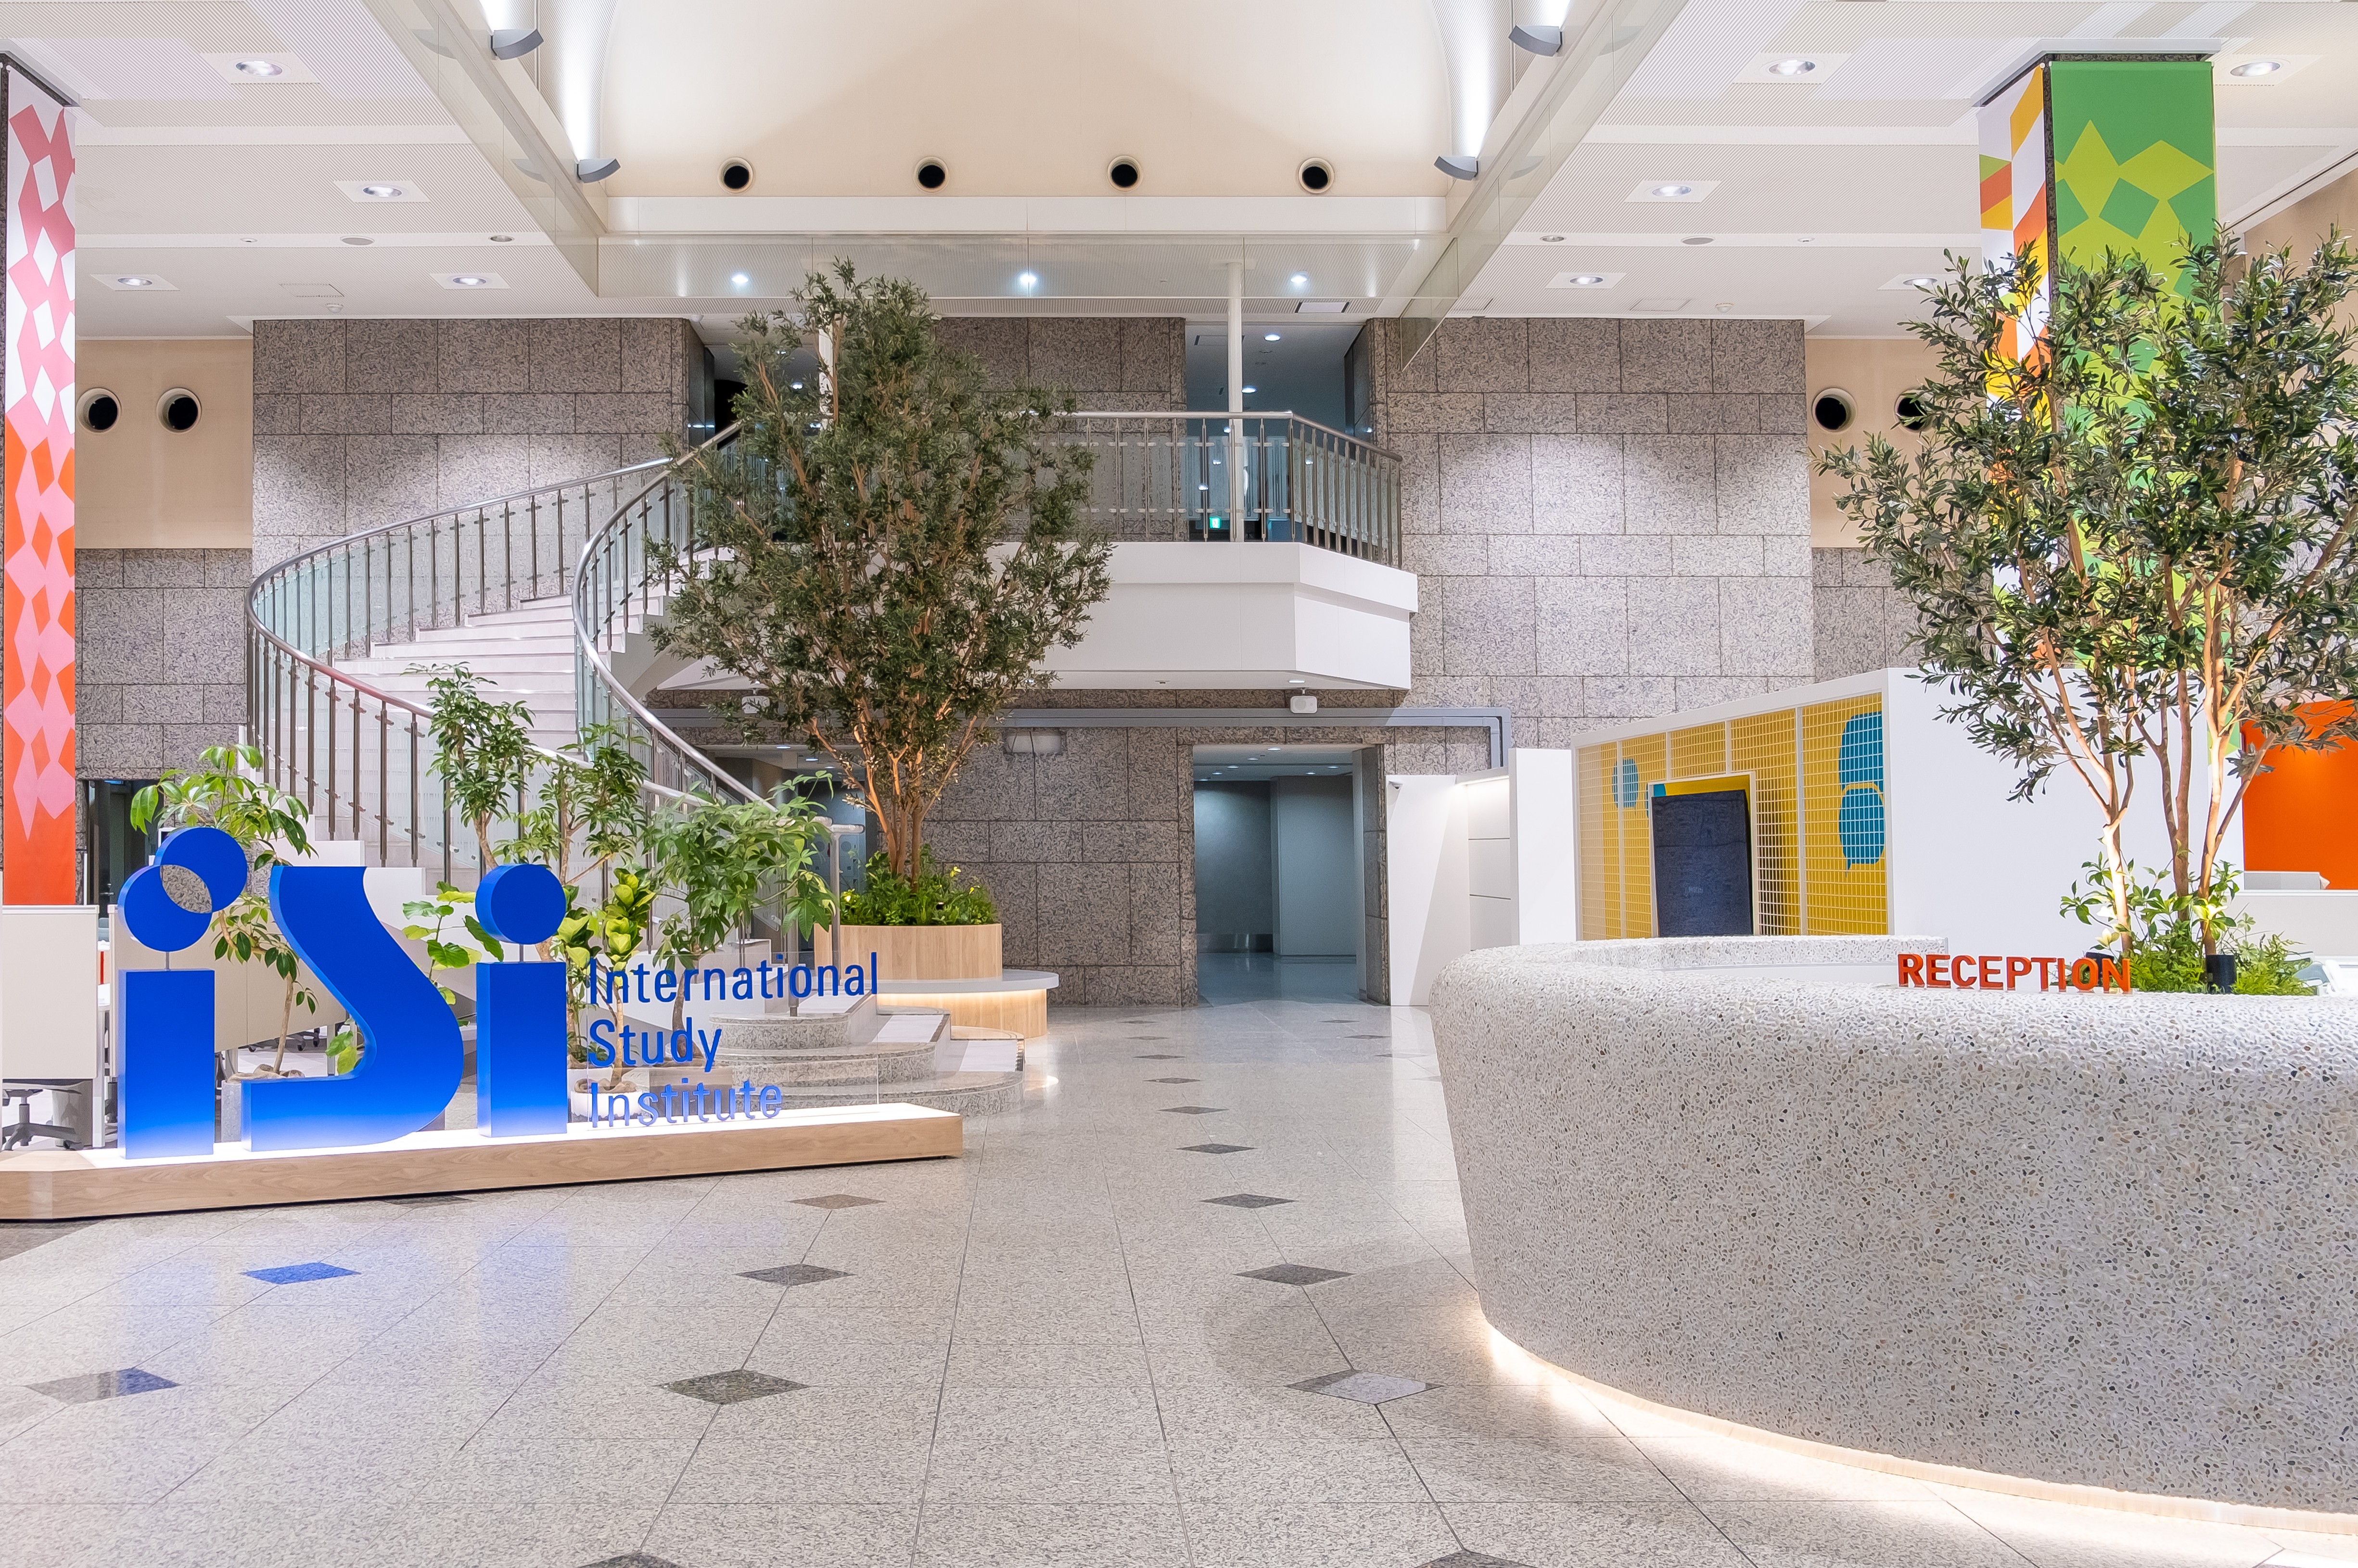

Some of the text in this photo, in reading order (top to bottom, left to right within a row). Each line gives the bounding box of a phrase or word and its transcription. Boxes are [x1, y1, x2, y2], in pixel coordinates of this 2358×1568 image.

[588, 952, 878, 1005] International
[1897, 954, 2131, 993] RECEPTION
[588, 1017, 723, 1072] Study
[590, 1077, 782, 1128] Institute
